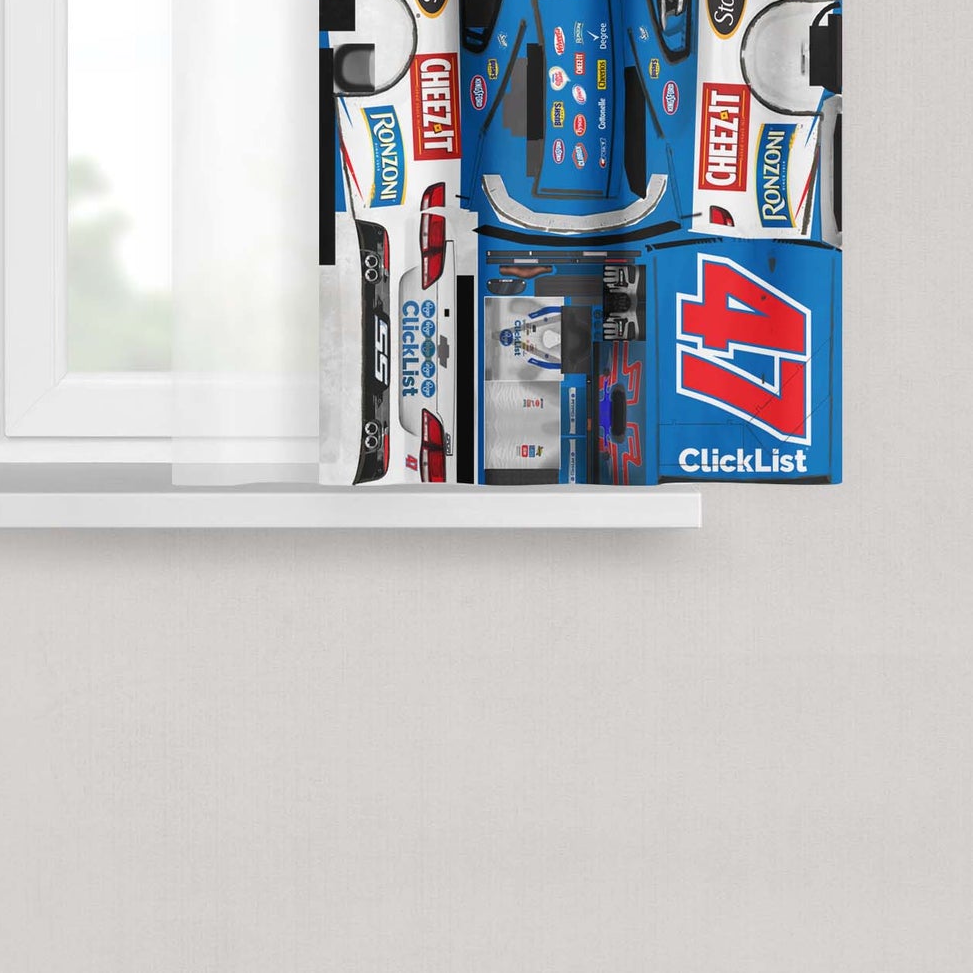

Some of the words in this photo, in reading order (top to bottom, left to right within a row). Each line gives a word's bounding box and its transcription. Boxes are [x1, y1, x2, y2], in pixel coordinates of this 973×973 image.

[599, 23, 608, 49] Degree
[598, 61, 606, 88] Cheerios
[597, 98, 606, 129] Cottonelle
[370, 113, 398, 201] RONZONI
[762, 130, 785, 221] RONZONI
[374, 315, 388, 386] SS
[402, 300, 419, 397] ClickList
[676, 253, 811, 445] 47
[678, 447, 808, 473] ClickList
